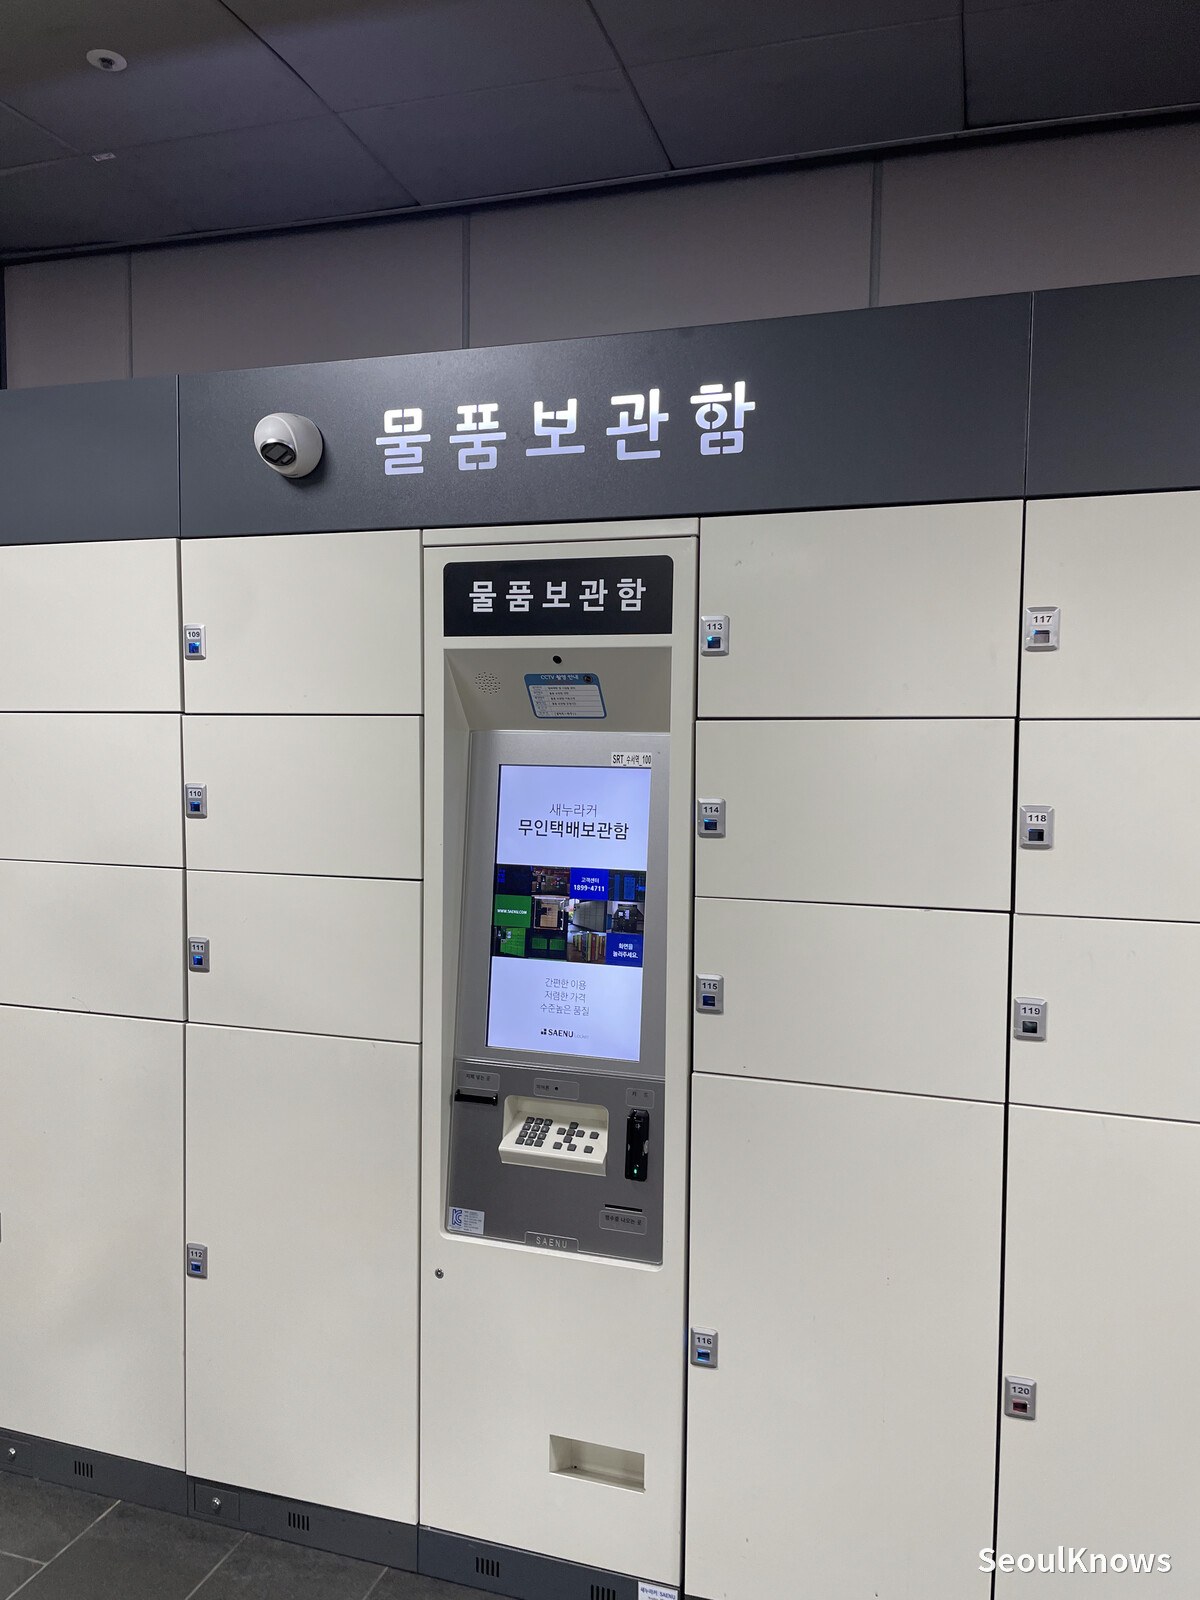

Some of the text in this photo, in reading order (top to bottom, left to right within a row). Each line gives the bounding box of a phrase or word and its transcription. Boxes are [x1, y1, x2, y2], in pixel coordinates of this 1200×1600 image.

[375, 380, 756, 476] 물품보관함
[468, 578, 647, 613] 물품보관함
[1033, 615, 1053, 623] 117
[706, 623, 723, 631] 113
[549, 803, 598, 817] 새누라커
[704, 806, 720, 814] 114
[1028, 814, 1047, 822] 118
[518, 819, 629, 841] 무인택배보관함
[573, 884, 605, 893] 1899-4711
[544, 977, 587, 991] 간편한 이용
[702, 982, 718, 990] 115
[544, 990, 586, 1003] 저렴한 가격
[540, 1003, 590, 1017] 수준높은 품질
[1022, 1006, 1041, 1015] 119
[548, 1028, 574, 1038] SAENU
[536, 1236, 569, 1249] SAENU
[190, 1250, 203, 1258] 112
[696, 1336, 712, 1345] 116
[1012, 1386, 1030, 1395] 120
